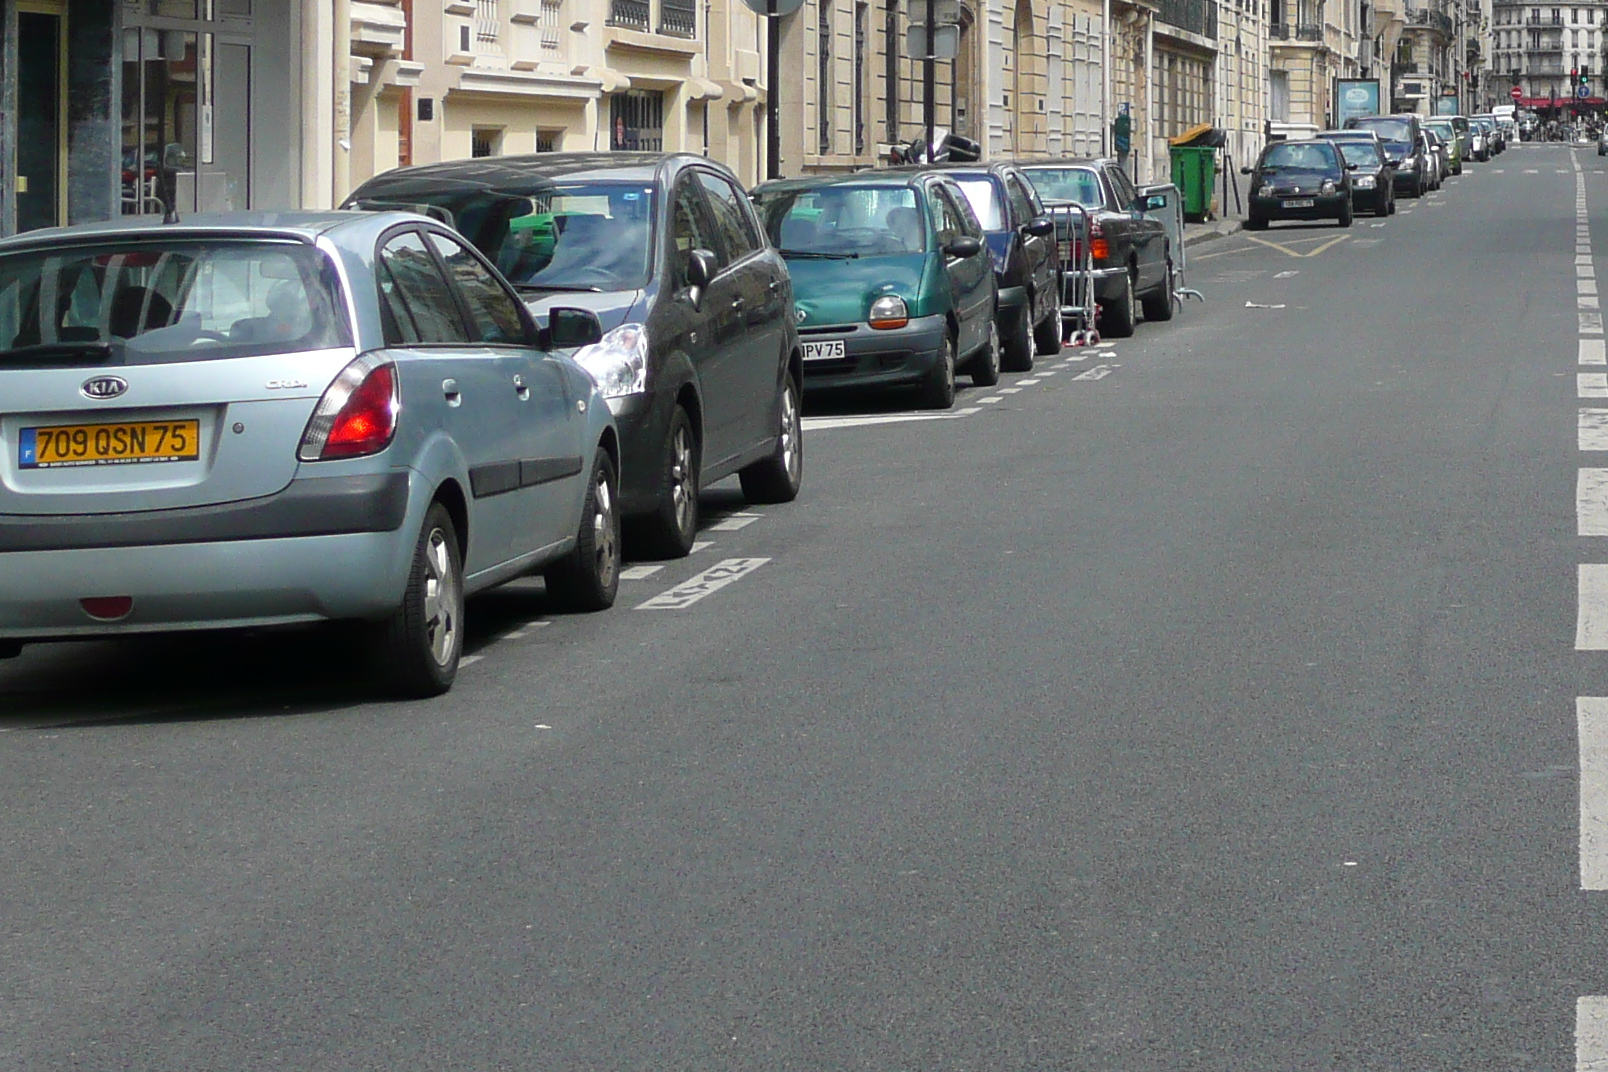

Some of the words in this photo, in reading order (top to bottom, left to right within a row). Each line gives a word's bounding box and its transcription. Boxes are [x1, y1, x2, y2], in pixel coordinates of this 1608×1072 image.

[825, 342, 843, 357] 75
[90, 380, 119, 394] KIA
[38, 430, 88, 460] 709
[95, 426, 146, 456] QSN
[152, 424, 186, 454] 75
